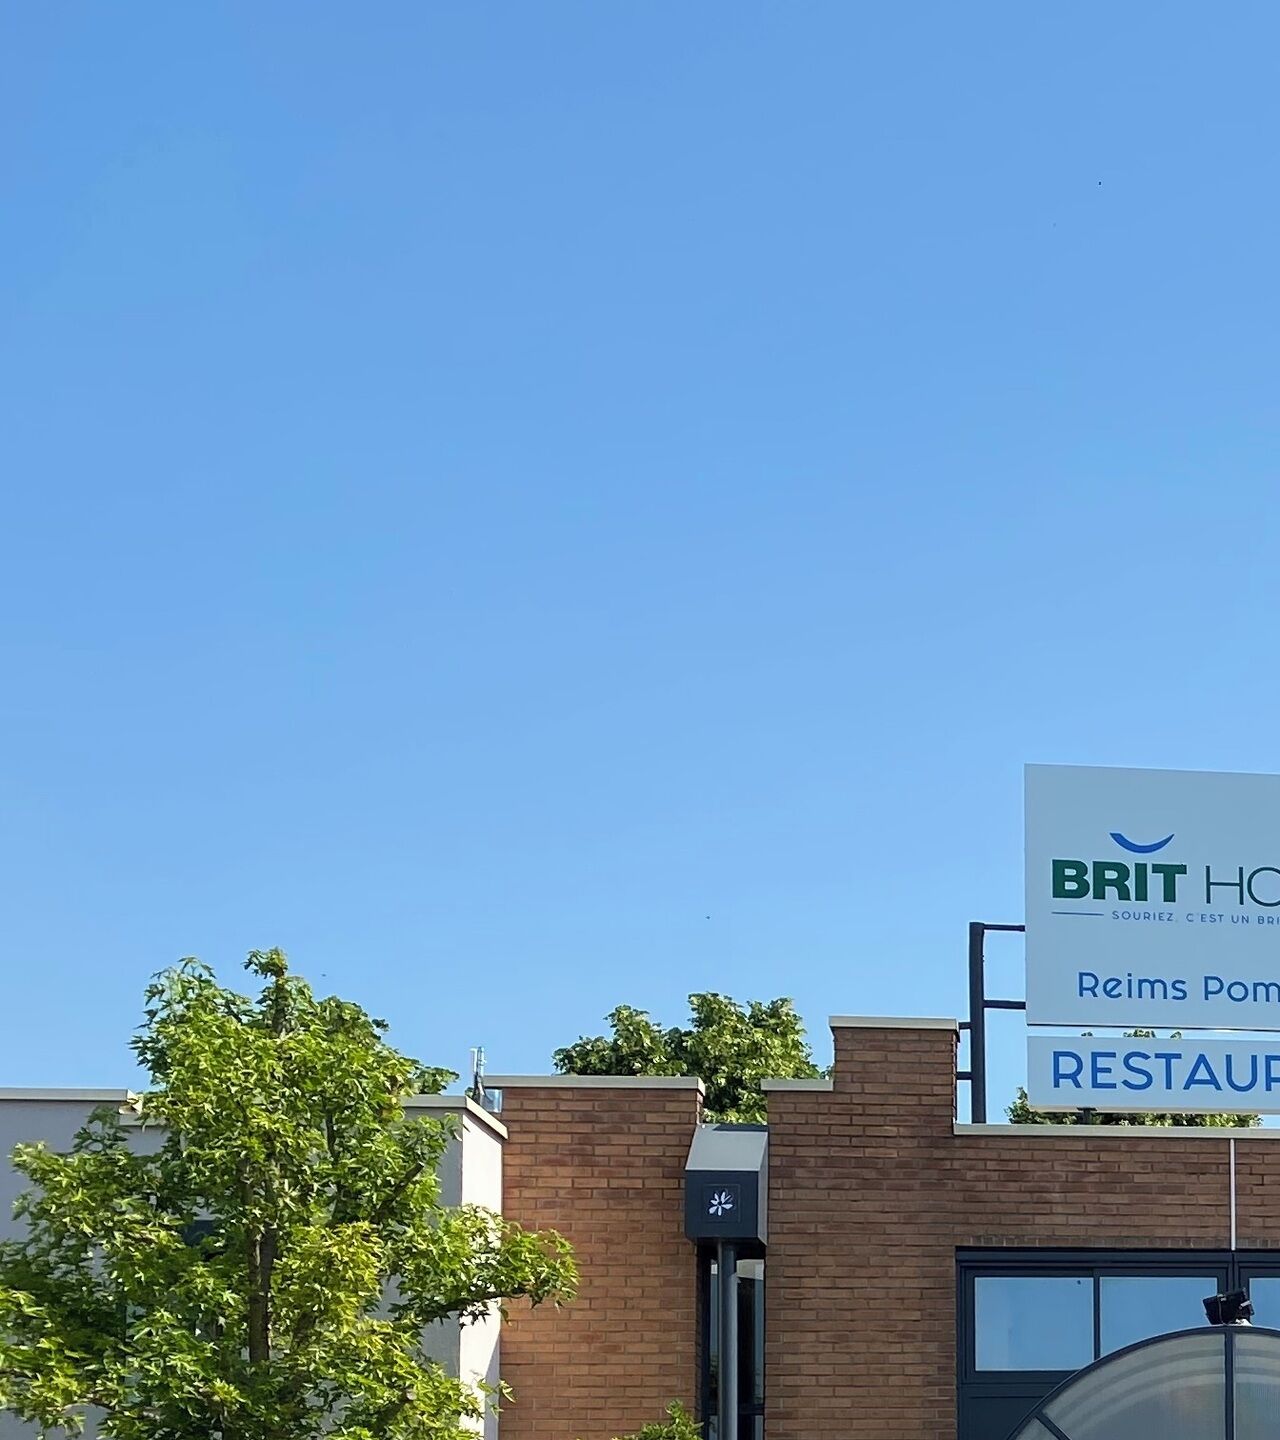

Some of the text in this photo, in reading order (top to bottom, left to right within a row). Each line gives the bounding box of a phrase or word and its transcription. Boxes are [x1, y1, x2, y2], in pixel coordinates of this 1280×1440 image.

[1052, 859, 1188, 903] BRIT
[1231, 914, 1250, 925] UN
[1078, 972, 1188, 1000] Reims
